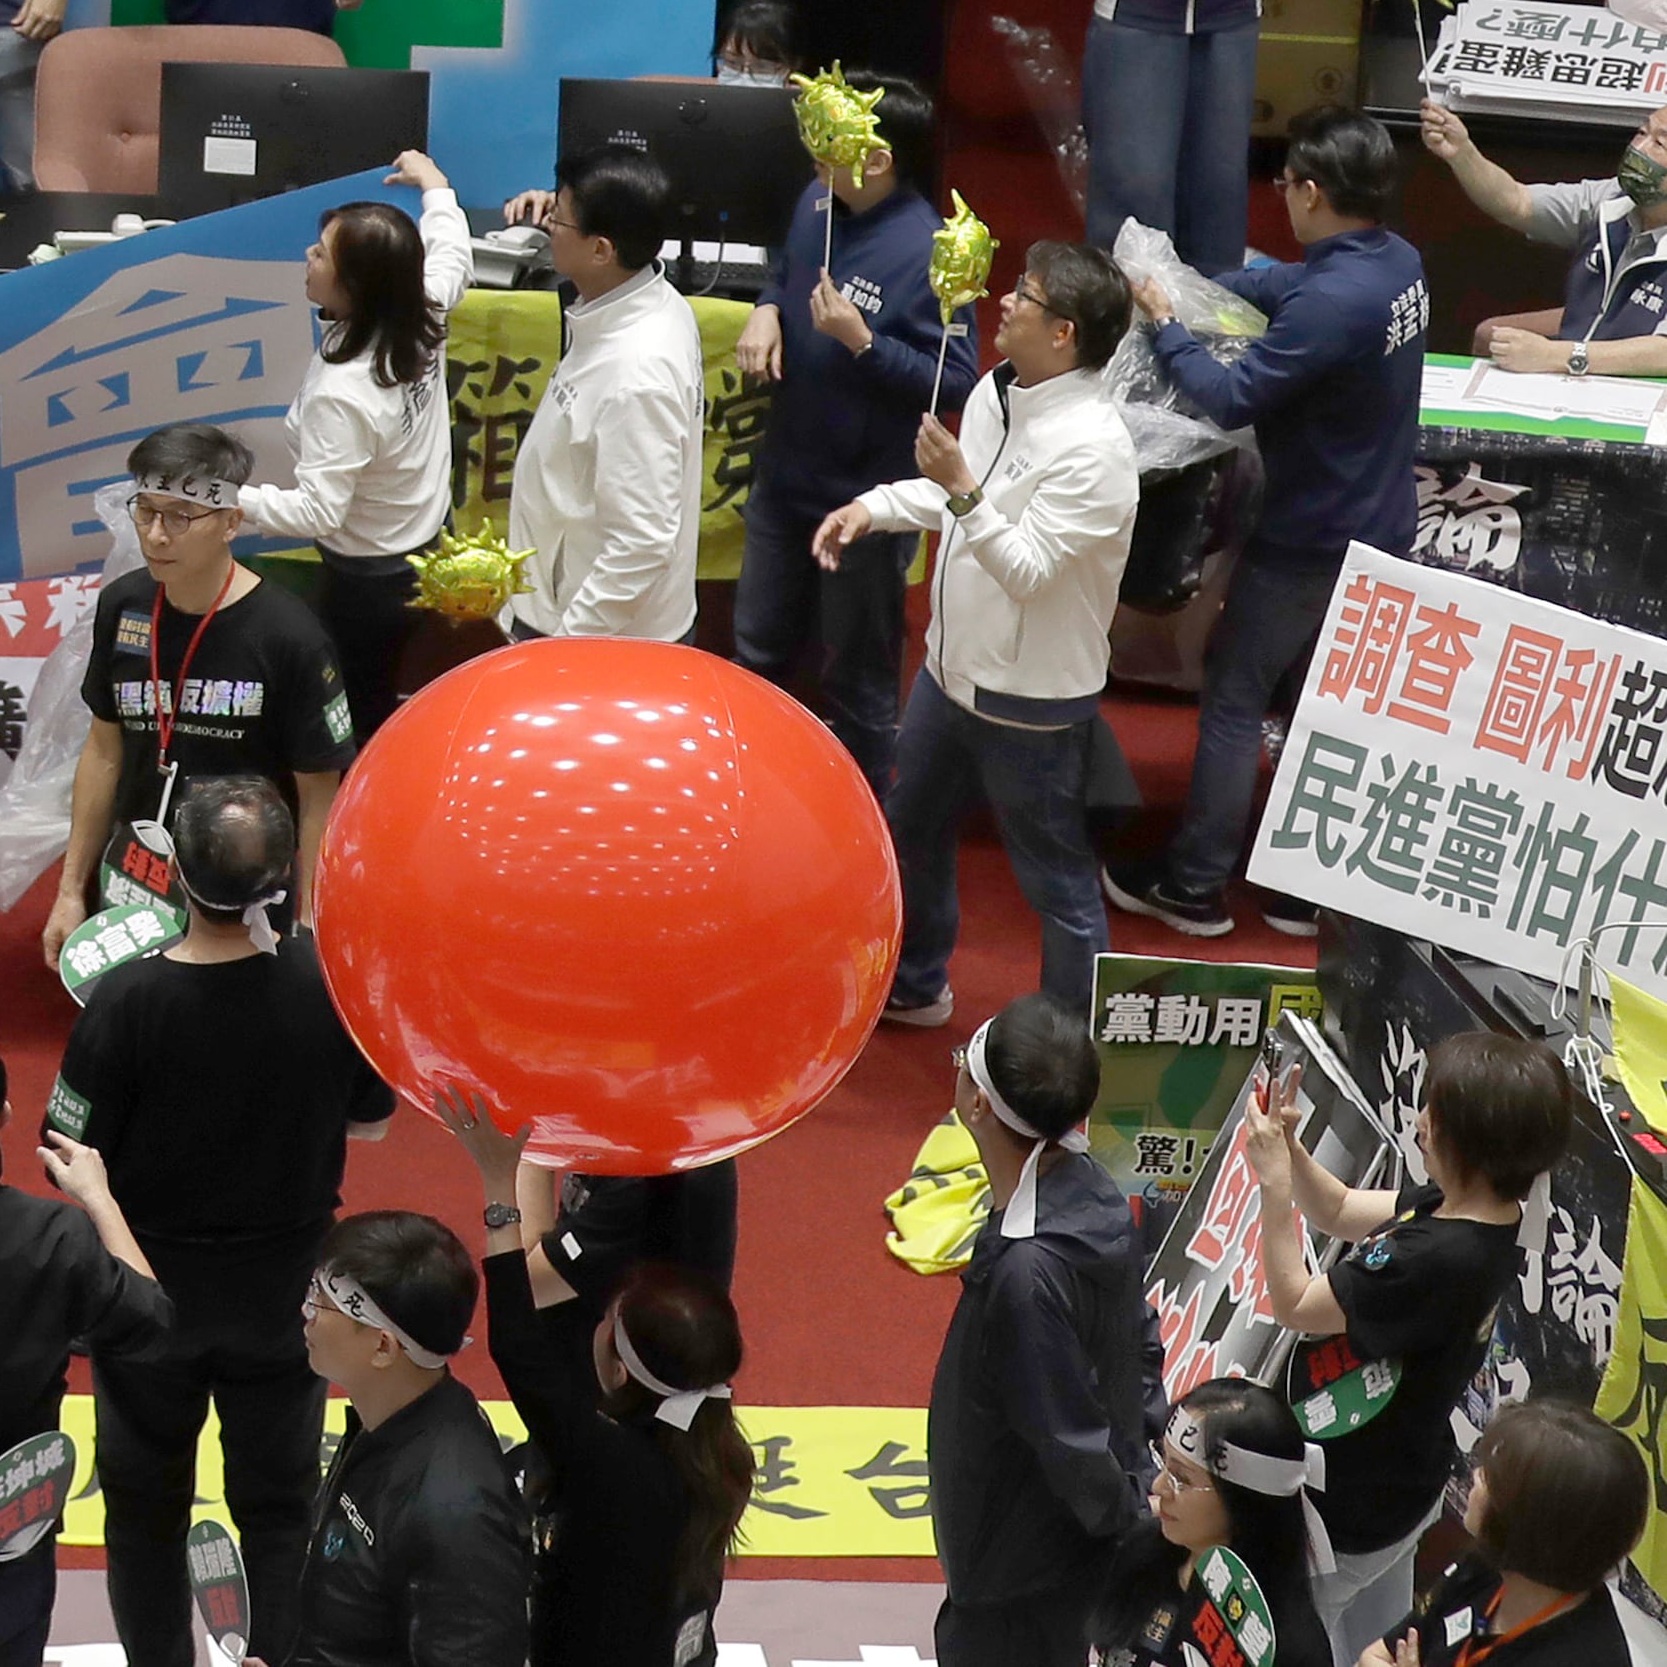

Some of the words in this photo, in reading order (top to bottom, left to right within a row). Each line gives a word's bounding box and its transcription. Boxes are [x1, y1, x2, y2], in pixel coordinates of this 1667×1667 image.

[1316, 573, 1483, 736] 調查
[1472, 621, 1667, 806] 圖利超
[1269, 731, 1667, 976] 民進黨怕什
